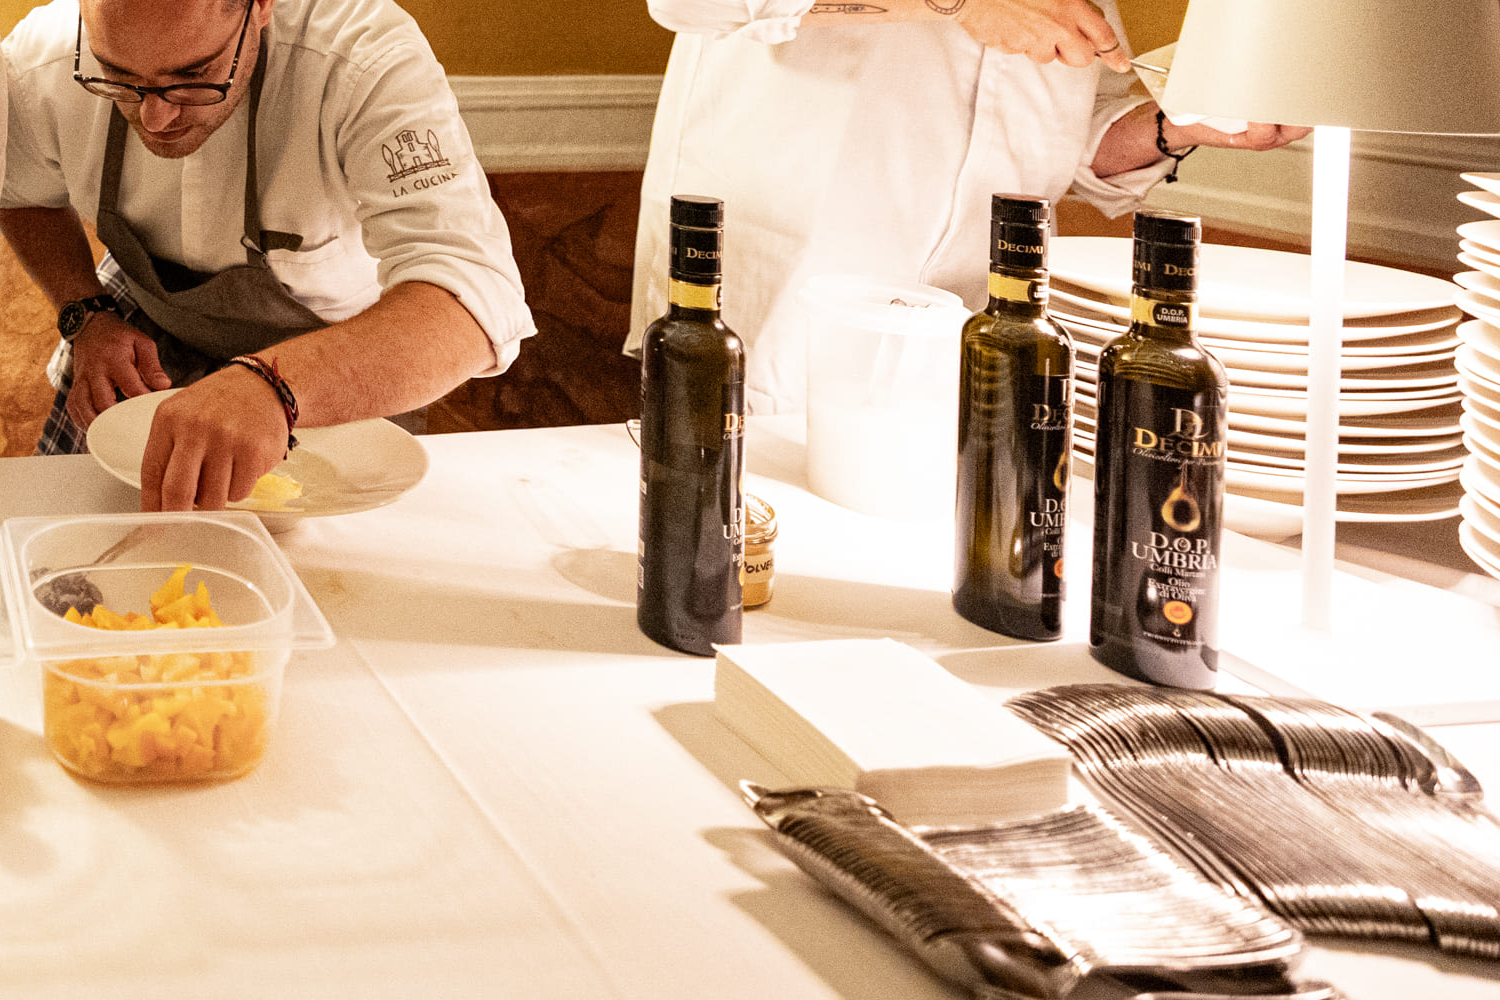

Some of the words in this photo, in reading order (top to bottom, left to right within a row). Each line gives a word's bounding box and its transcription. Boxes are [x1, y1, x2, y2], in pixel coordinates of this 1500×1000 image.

[392, 186, 409, 198] LA
[413, 172, 460, 191] CUCINA
[997, 239, 1044, 255] DECIMI
[1156, 313, 1188, 324] UMBRIA
[1161, 307, 1184, 317] D.O.P.
[1150, 531, 1211, 555] D.O.P.
[1131, 541, 1218, 571] UMBRIA
